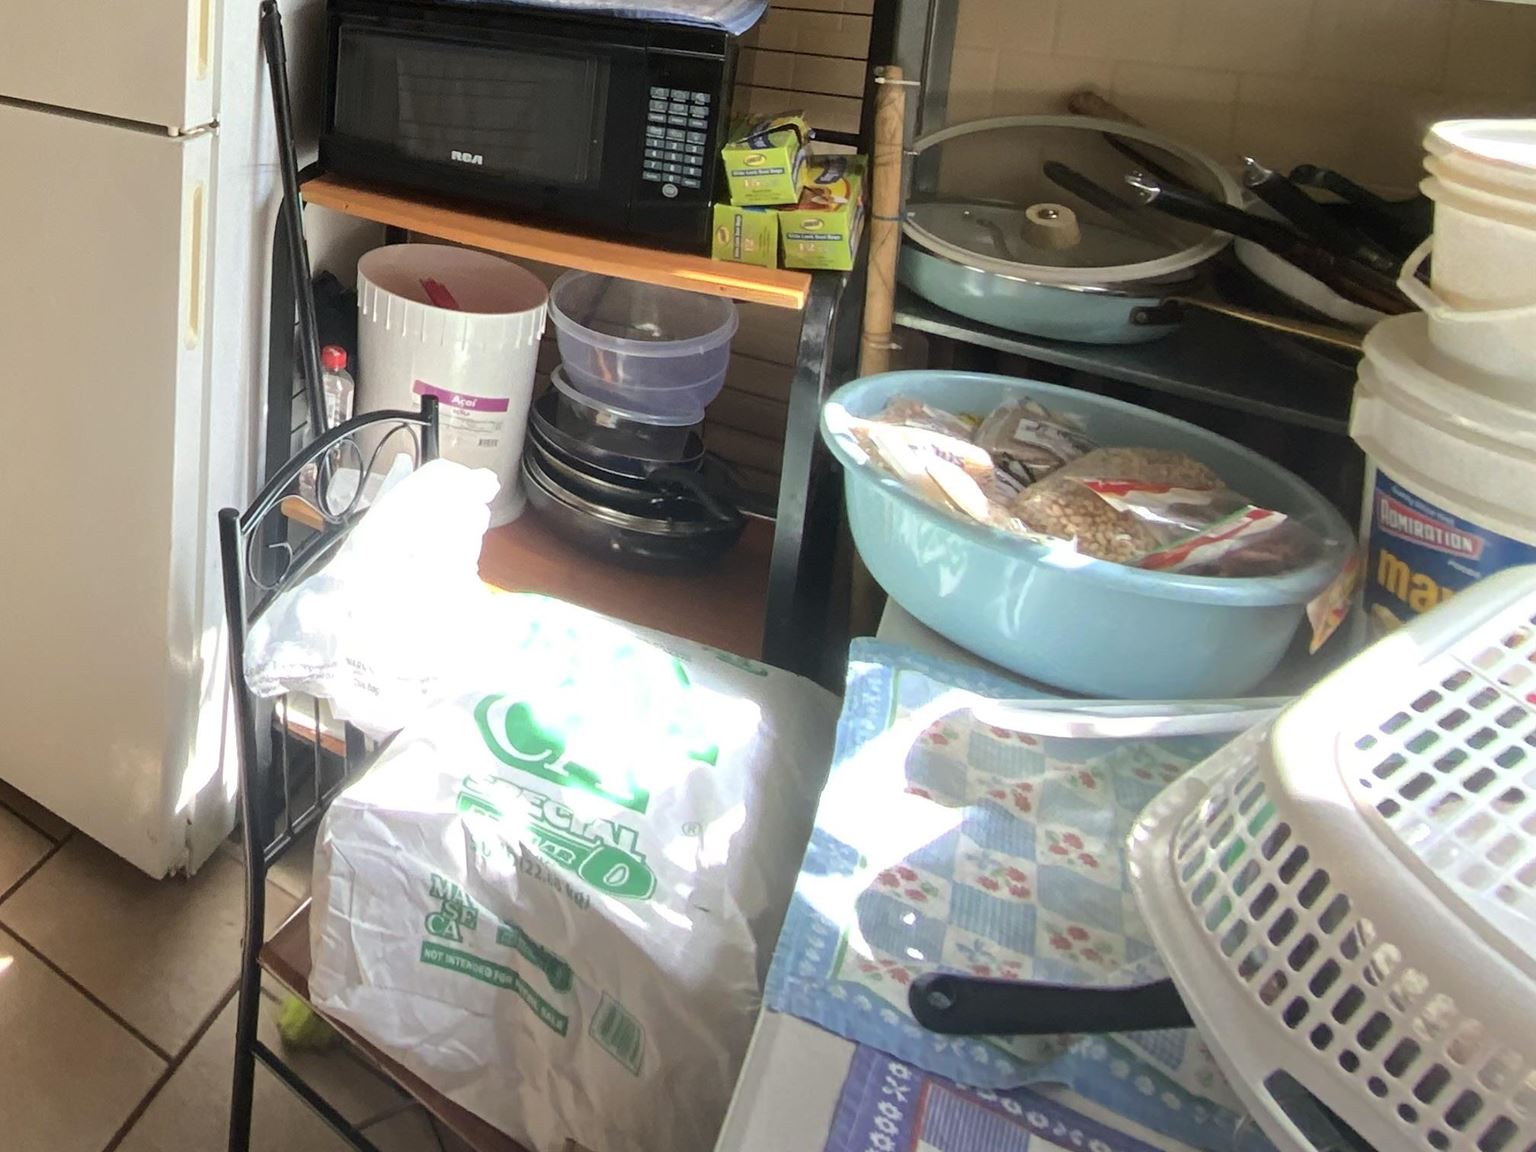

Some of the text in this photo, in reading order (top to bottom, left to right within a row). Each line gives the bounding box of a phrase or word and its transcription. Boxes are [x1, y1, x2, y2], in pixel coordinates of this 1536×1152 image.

[451, 150, 483, 165] RCA
[1380, 498, 1474, 552] ADMIRATION
[425, 912, 462, 942] CA
[424, 949, 443, 962] NOT
[444, 953, 493, 978] INTENDED
